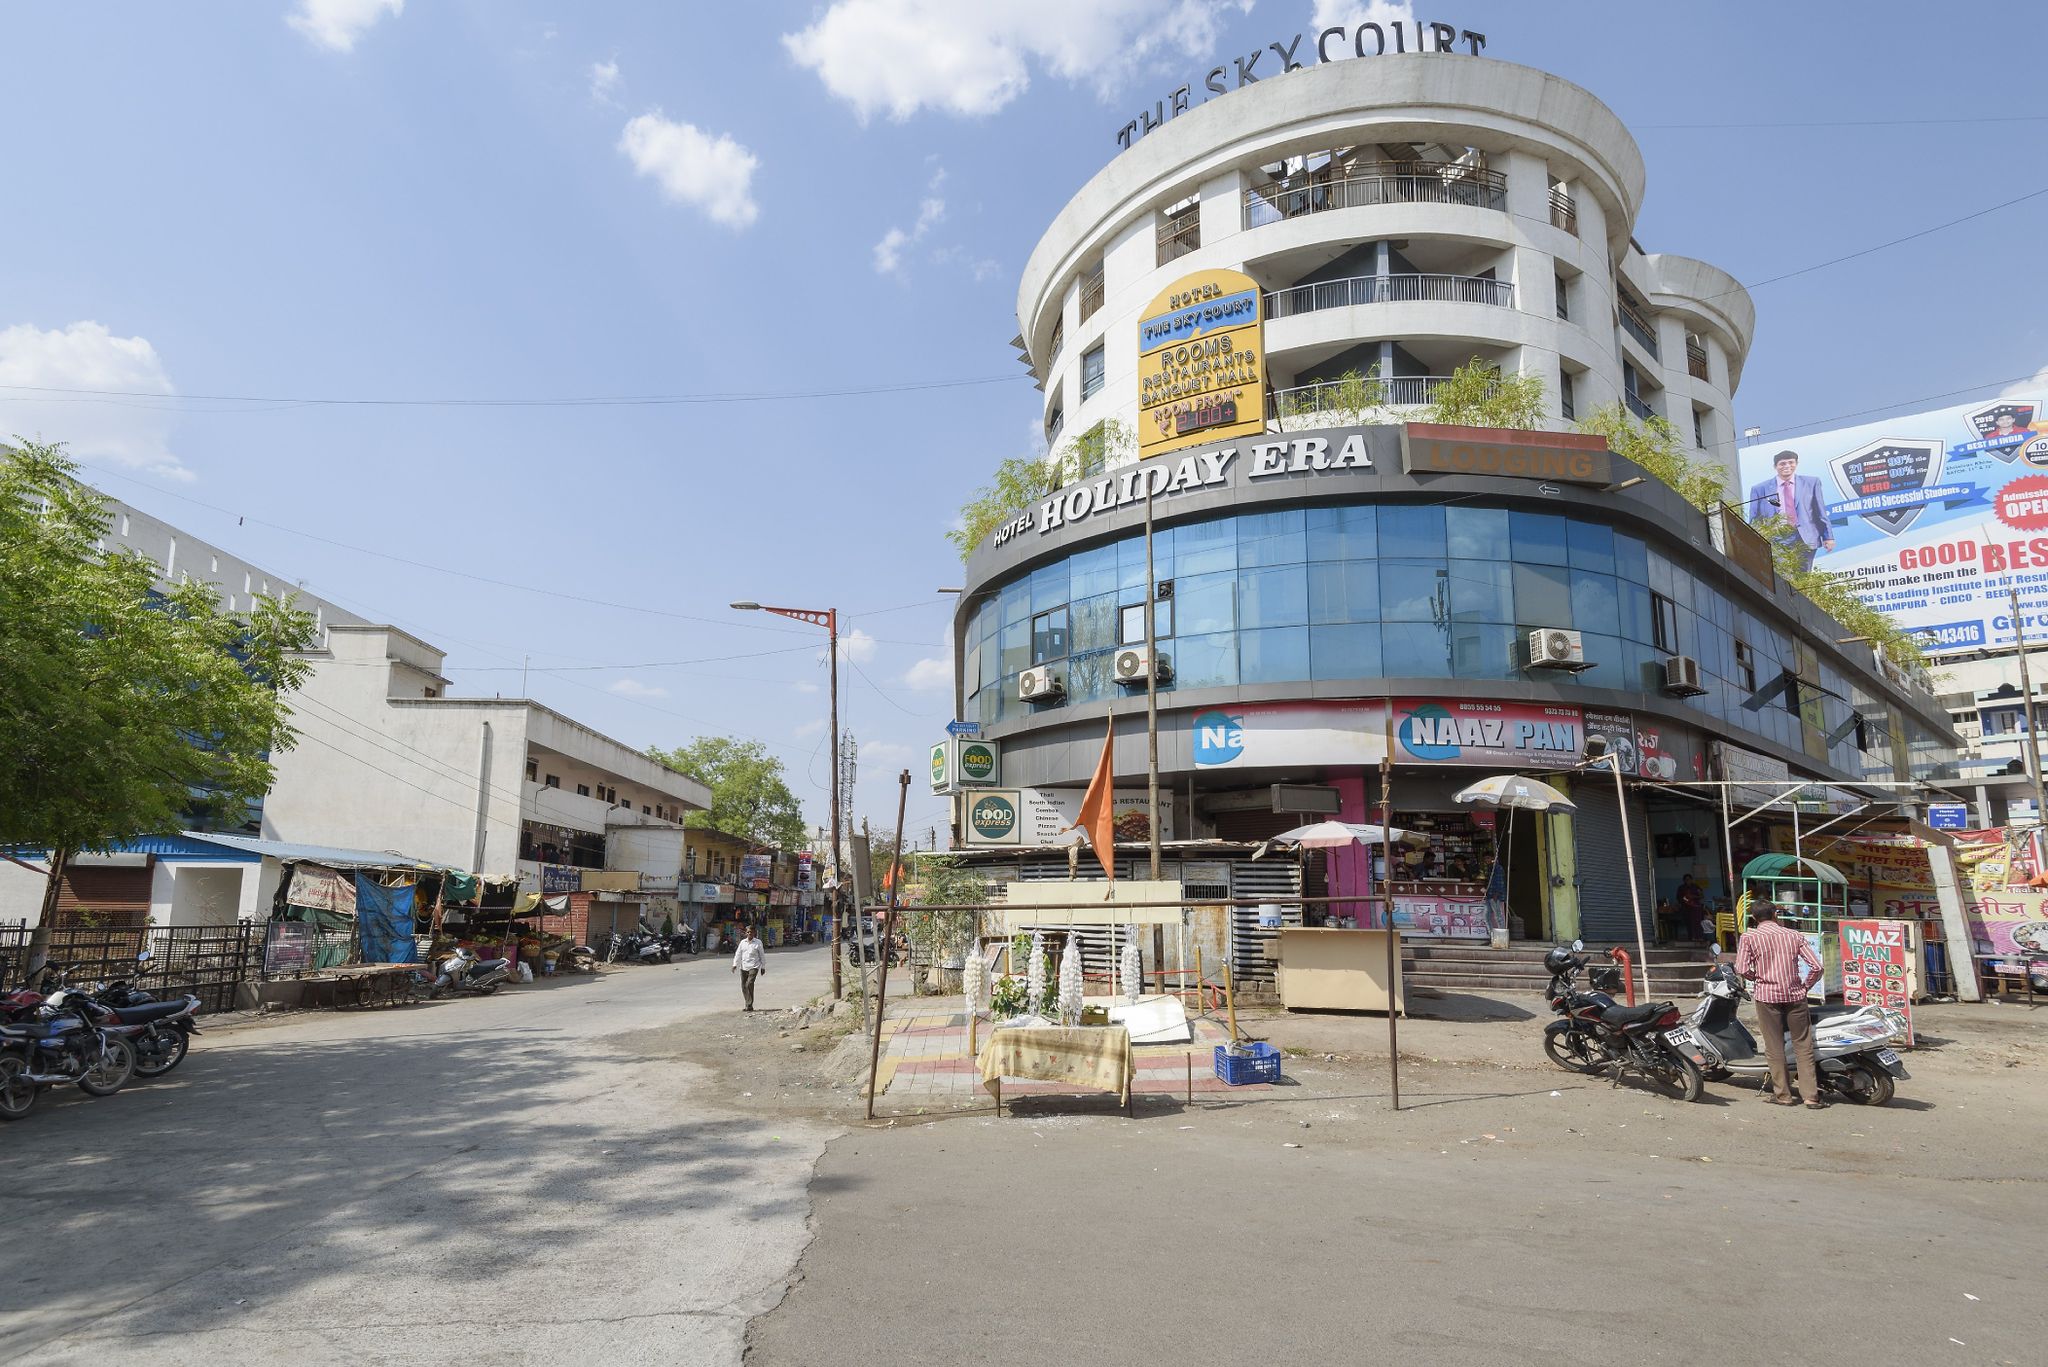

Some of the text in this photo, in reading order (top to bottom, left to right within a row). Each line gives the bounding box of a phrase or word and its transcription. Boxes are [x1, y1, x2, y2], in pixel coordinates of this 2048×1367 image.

[1117, 21, 1487, 150] THE SKY COURT
[1169, 283, 1222, 308] HOTEL
[1143, 298, 1253, 339] THE SKY COURT
[1161, 336, 1232, 369] ROOMS
[1142, 350, 1254, 389] RESTAURANTS
[1141, 366, 1255, 405] BANQUET HALL
[1154, 401, 1192, 422] ROOM
[1974, 415, 1994, 424] 2019
[1966, 434, 2024, 451] BEST IN INDIA
[1431, 444, 1594, 478] LODGING
[1848, 463, 1863, 474] 21
[994, 434, 1373, 548] HOTEL HOLIDAY ERA
[1862, 482, 1890, 493] HERO
[1831, 506, 1842, 514] JEE
[1843, 501, 1862, 512] MAIN
[1862, 497, 1881, 510] 2019
[1881, 487, 1924, 507] Successful
[1925, 485, 1960, 499] Students
[1857, 565, 1885, 576] Child
[1887, 564, 1898, 573] is
[1899, 540, 1977, 570] GOOD
[1888, 575, 1920, 587] make
[1923, 571, 1955, 582] them
[1957, 566, 1977, 577] the
[1885, 588, 1930, 601] Leading
[1932, 578, 1982, 595] Institute
[1985, 577, 1996, 588] in
[1999, 575, 2013, 587] IIT
[1940, 593, 1972, 606] CIDCO
[1985, 589, 2010, 599] BEED
[1411, 717, 1575, 751] NAAZ PAN
[964, 755, 992, 764] FOOD
[1120, 798, 1172, 808] RESTAUNT
[975, 809, 1013, 820] FOOD
[975, 819, 1011, 828] express
[1848, 929, 1901, 946] NAAZ
[1851, 944, 1891, 962] PAN
[1669, 1030, 1692, 1044] 7774
